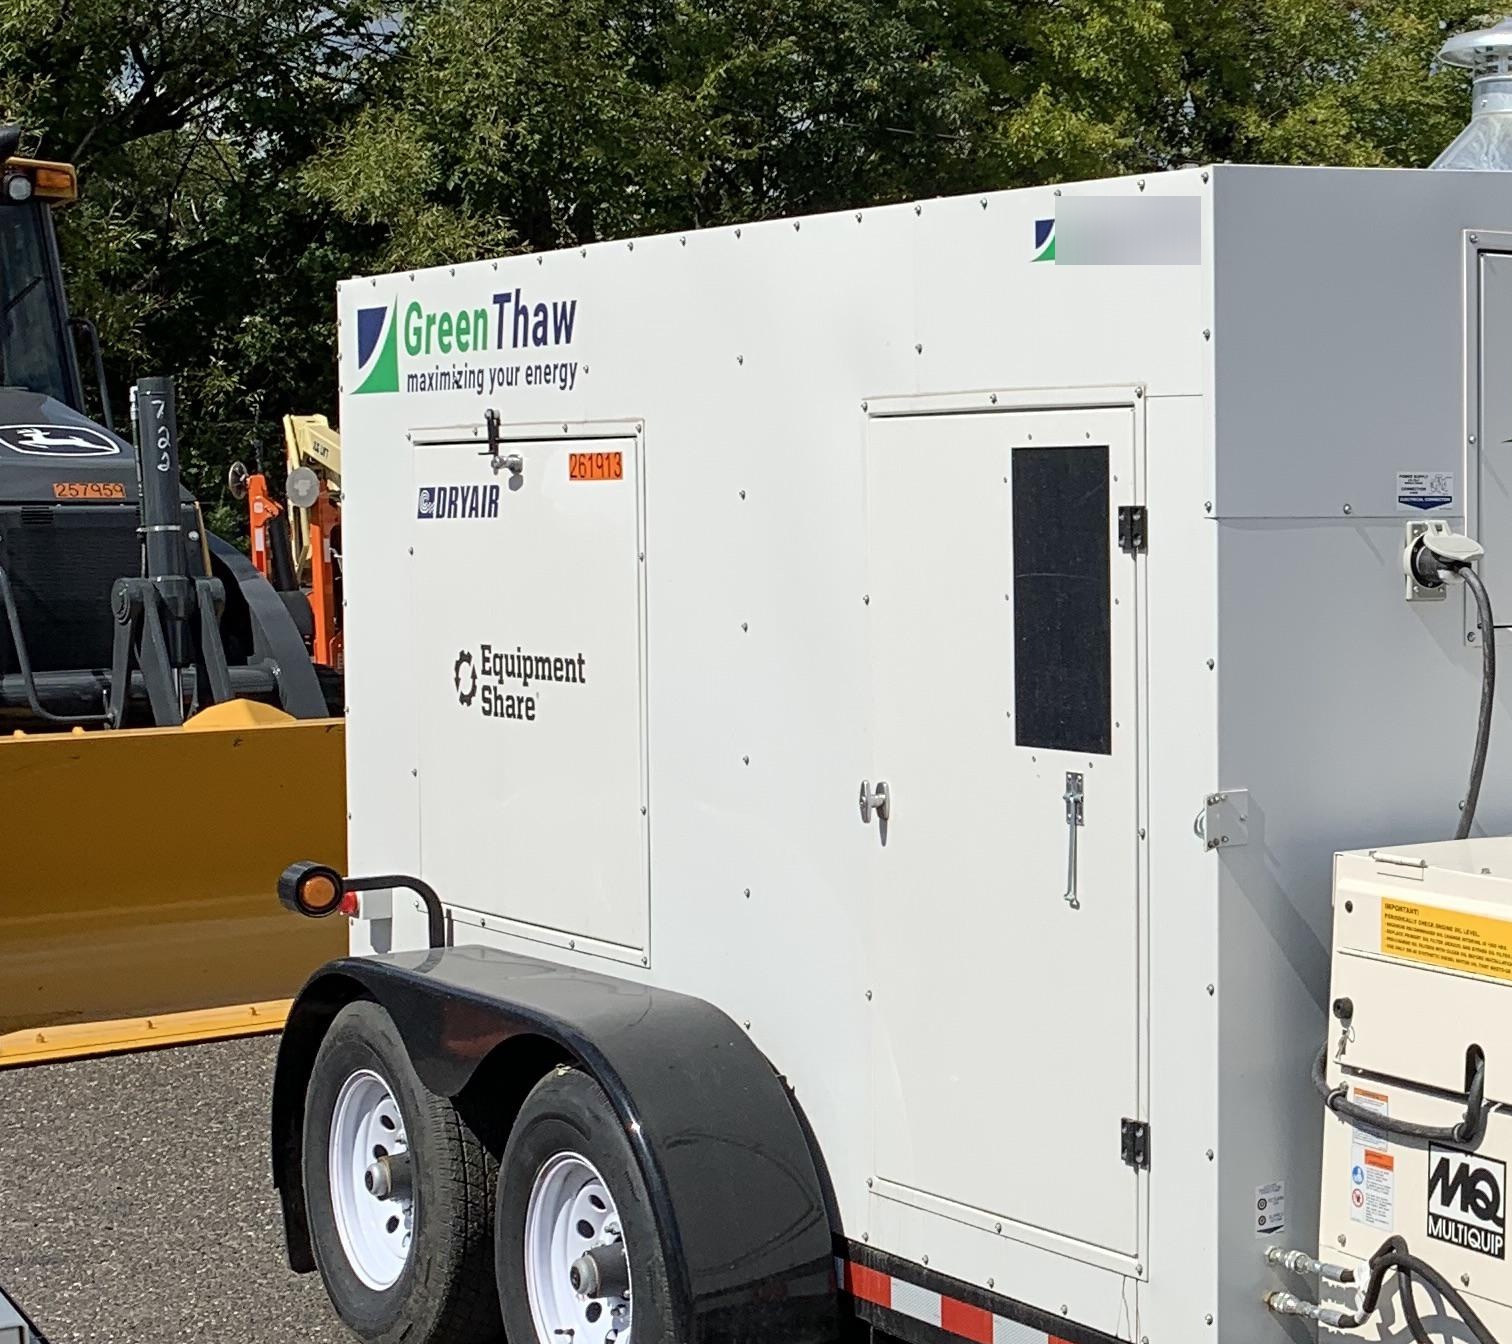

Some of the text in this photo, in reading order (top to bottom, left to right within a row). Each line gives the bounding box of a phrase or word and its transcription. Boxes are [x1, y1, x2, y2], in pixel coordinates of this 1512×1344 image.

[404, 289, 577, 355] Green Thaw
[406, 361, 578, 396] maximizing your energy
[569, 453, 623, 480] 261913
[55, 484, 124, 498] 257959
[436, 485, 499, 519] DRYAIR
[481, 644, 586, 685] Equipment
[481, 686, 536, 722] Share
[1429, 1157, 1504, 1228] MQ
[1429, 1215, 1503, 1255] MULTIQUIP
